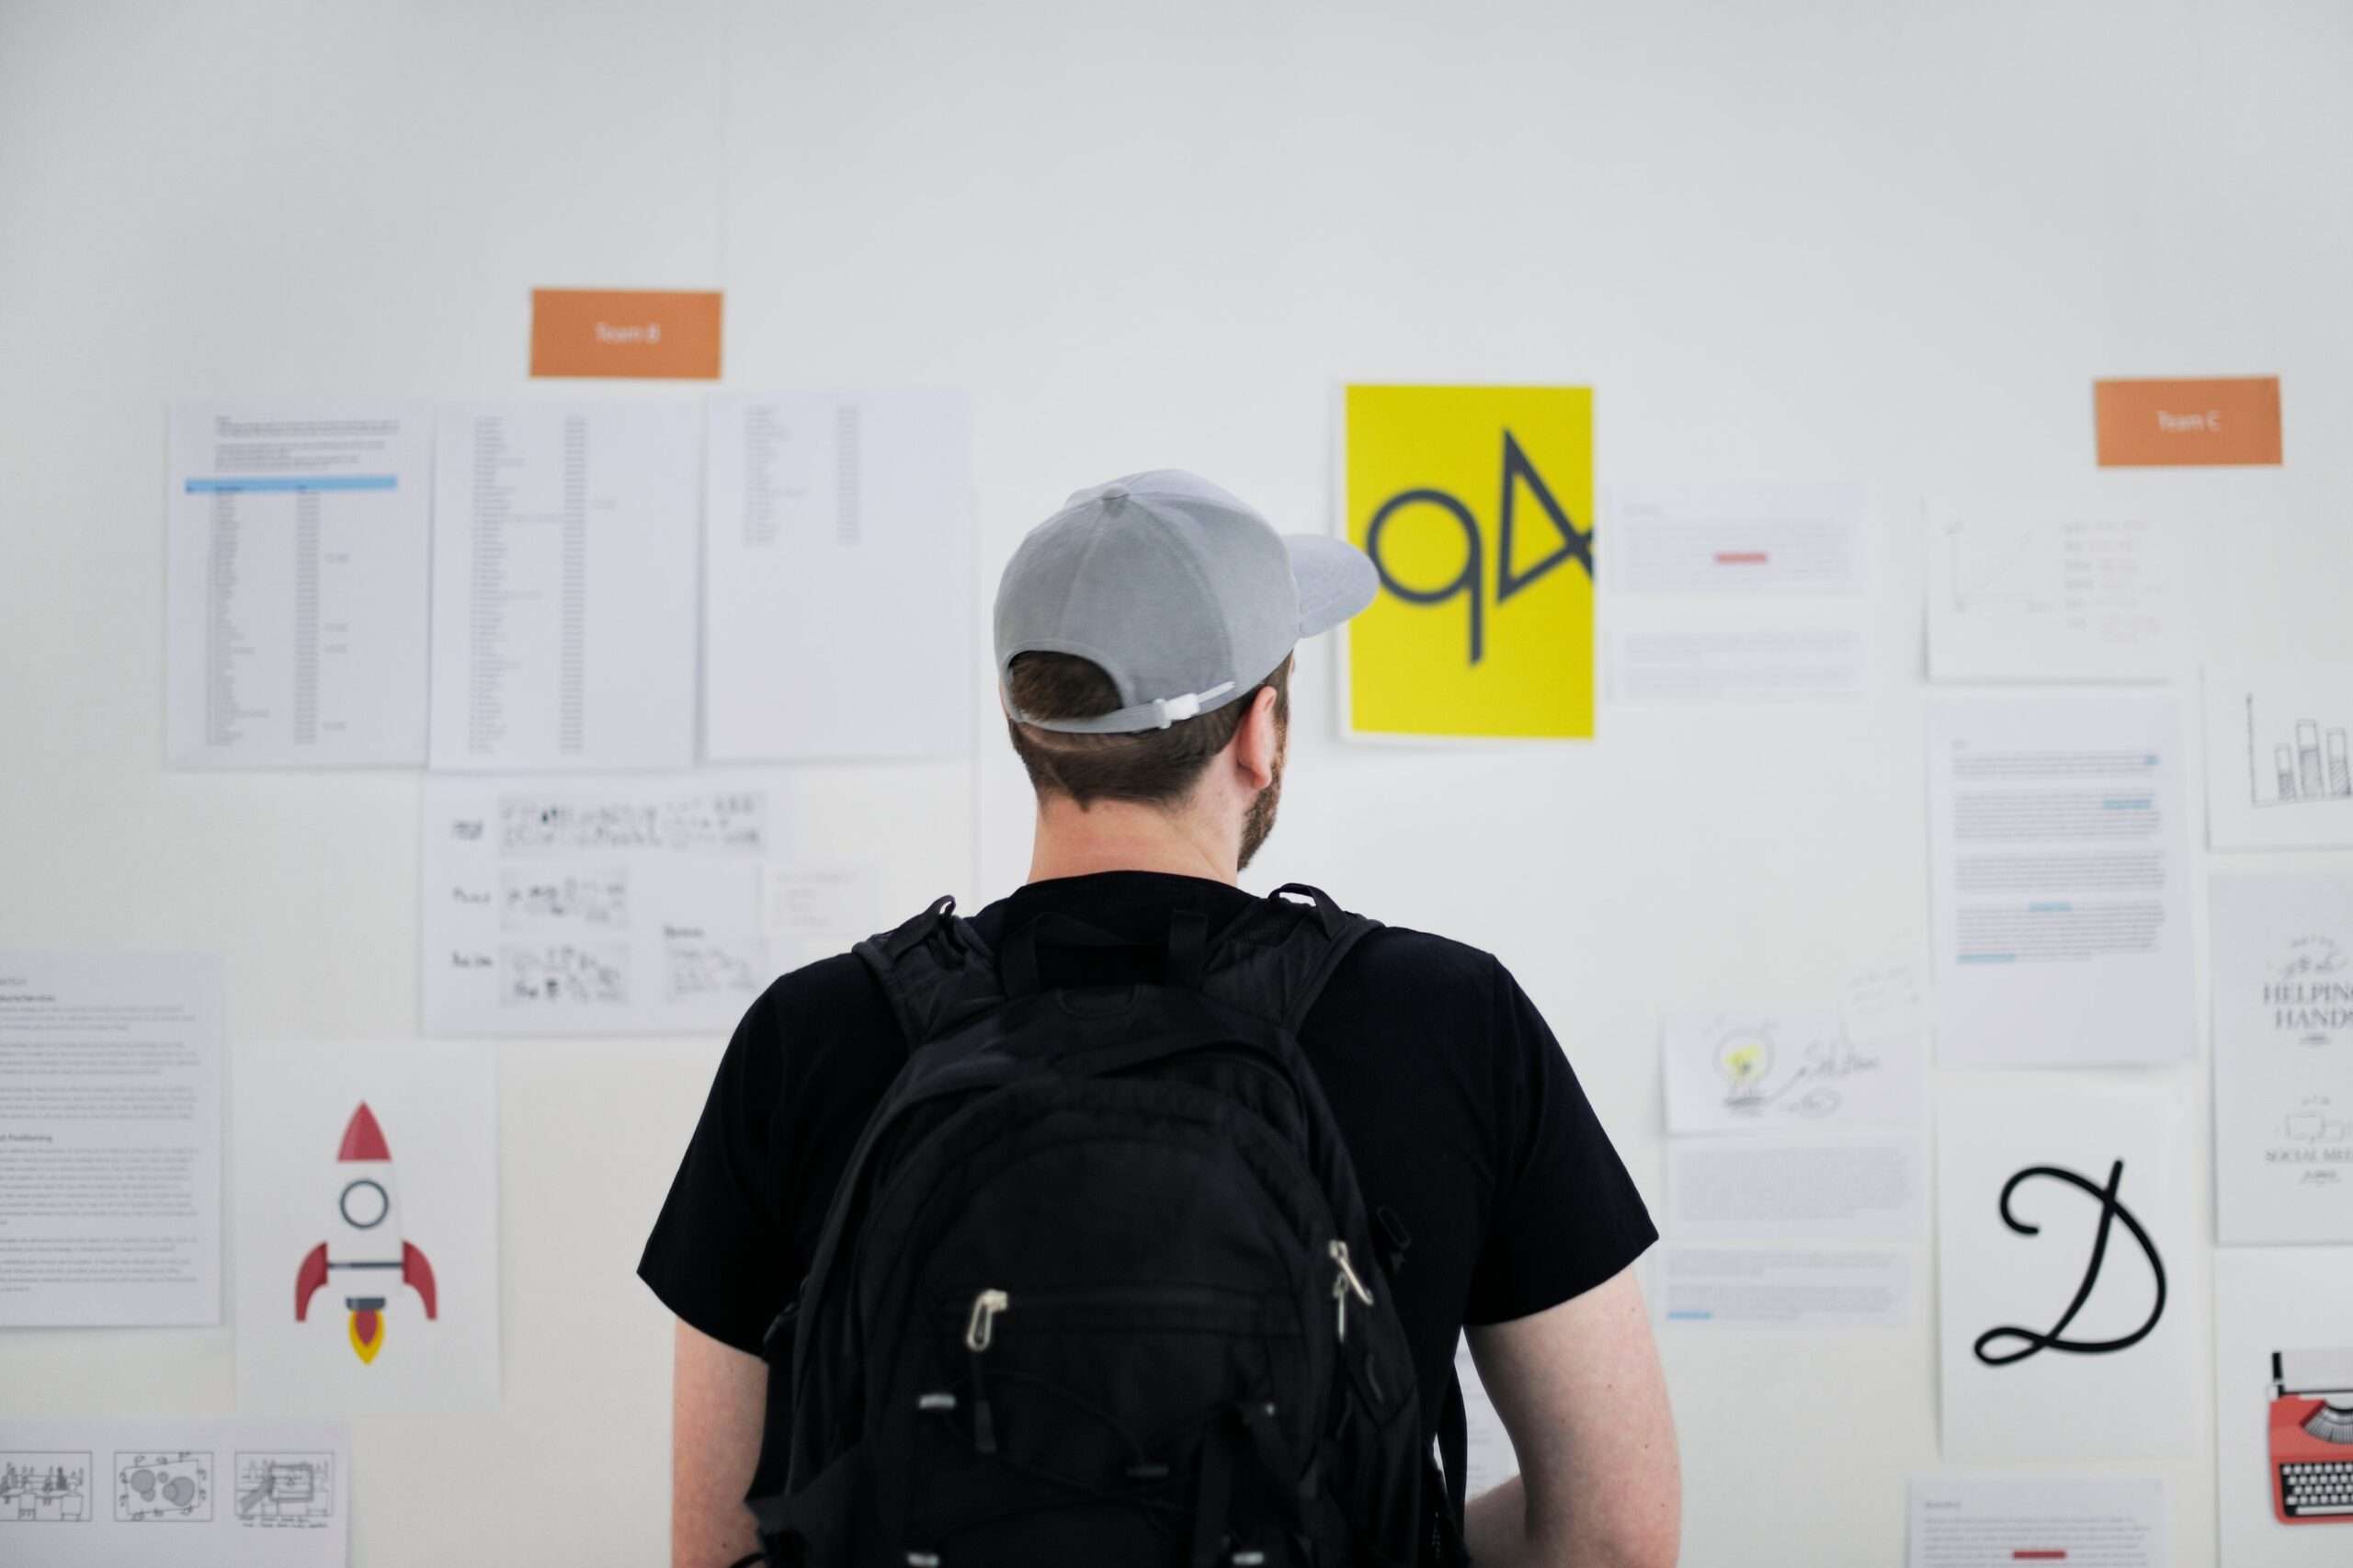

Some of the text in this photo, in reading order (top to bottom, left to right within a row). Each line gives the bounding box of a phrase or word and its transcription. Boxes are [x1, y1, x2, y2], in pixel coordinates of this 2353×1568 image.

[595, 323, 646, 345] Team
[2157, 411, 2222, 433] Team C
[2263, 983, 2353, 1005] HELPIN
[1973, 1159, 2167, 1367] D
